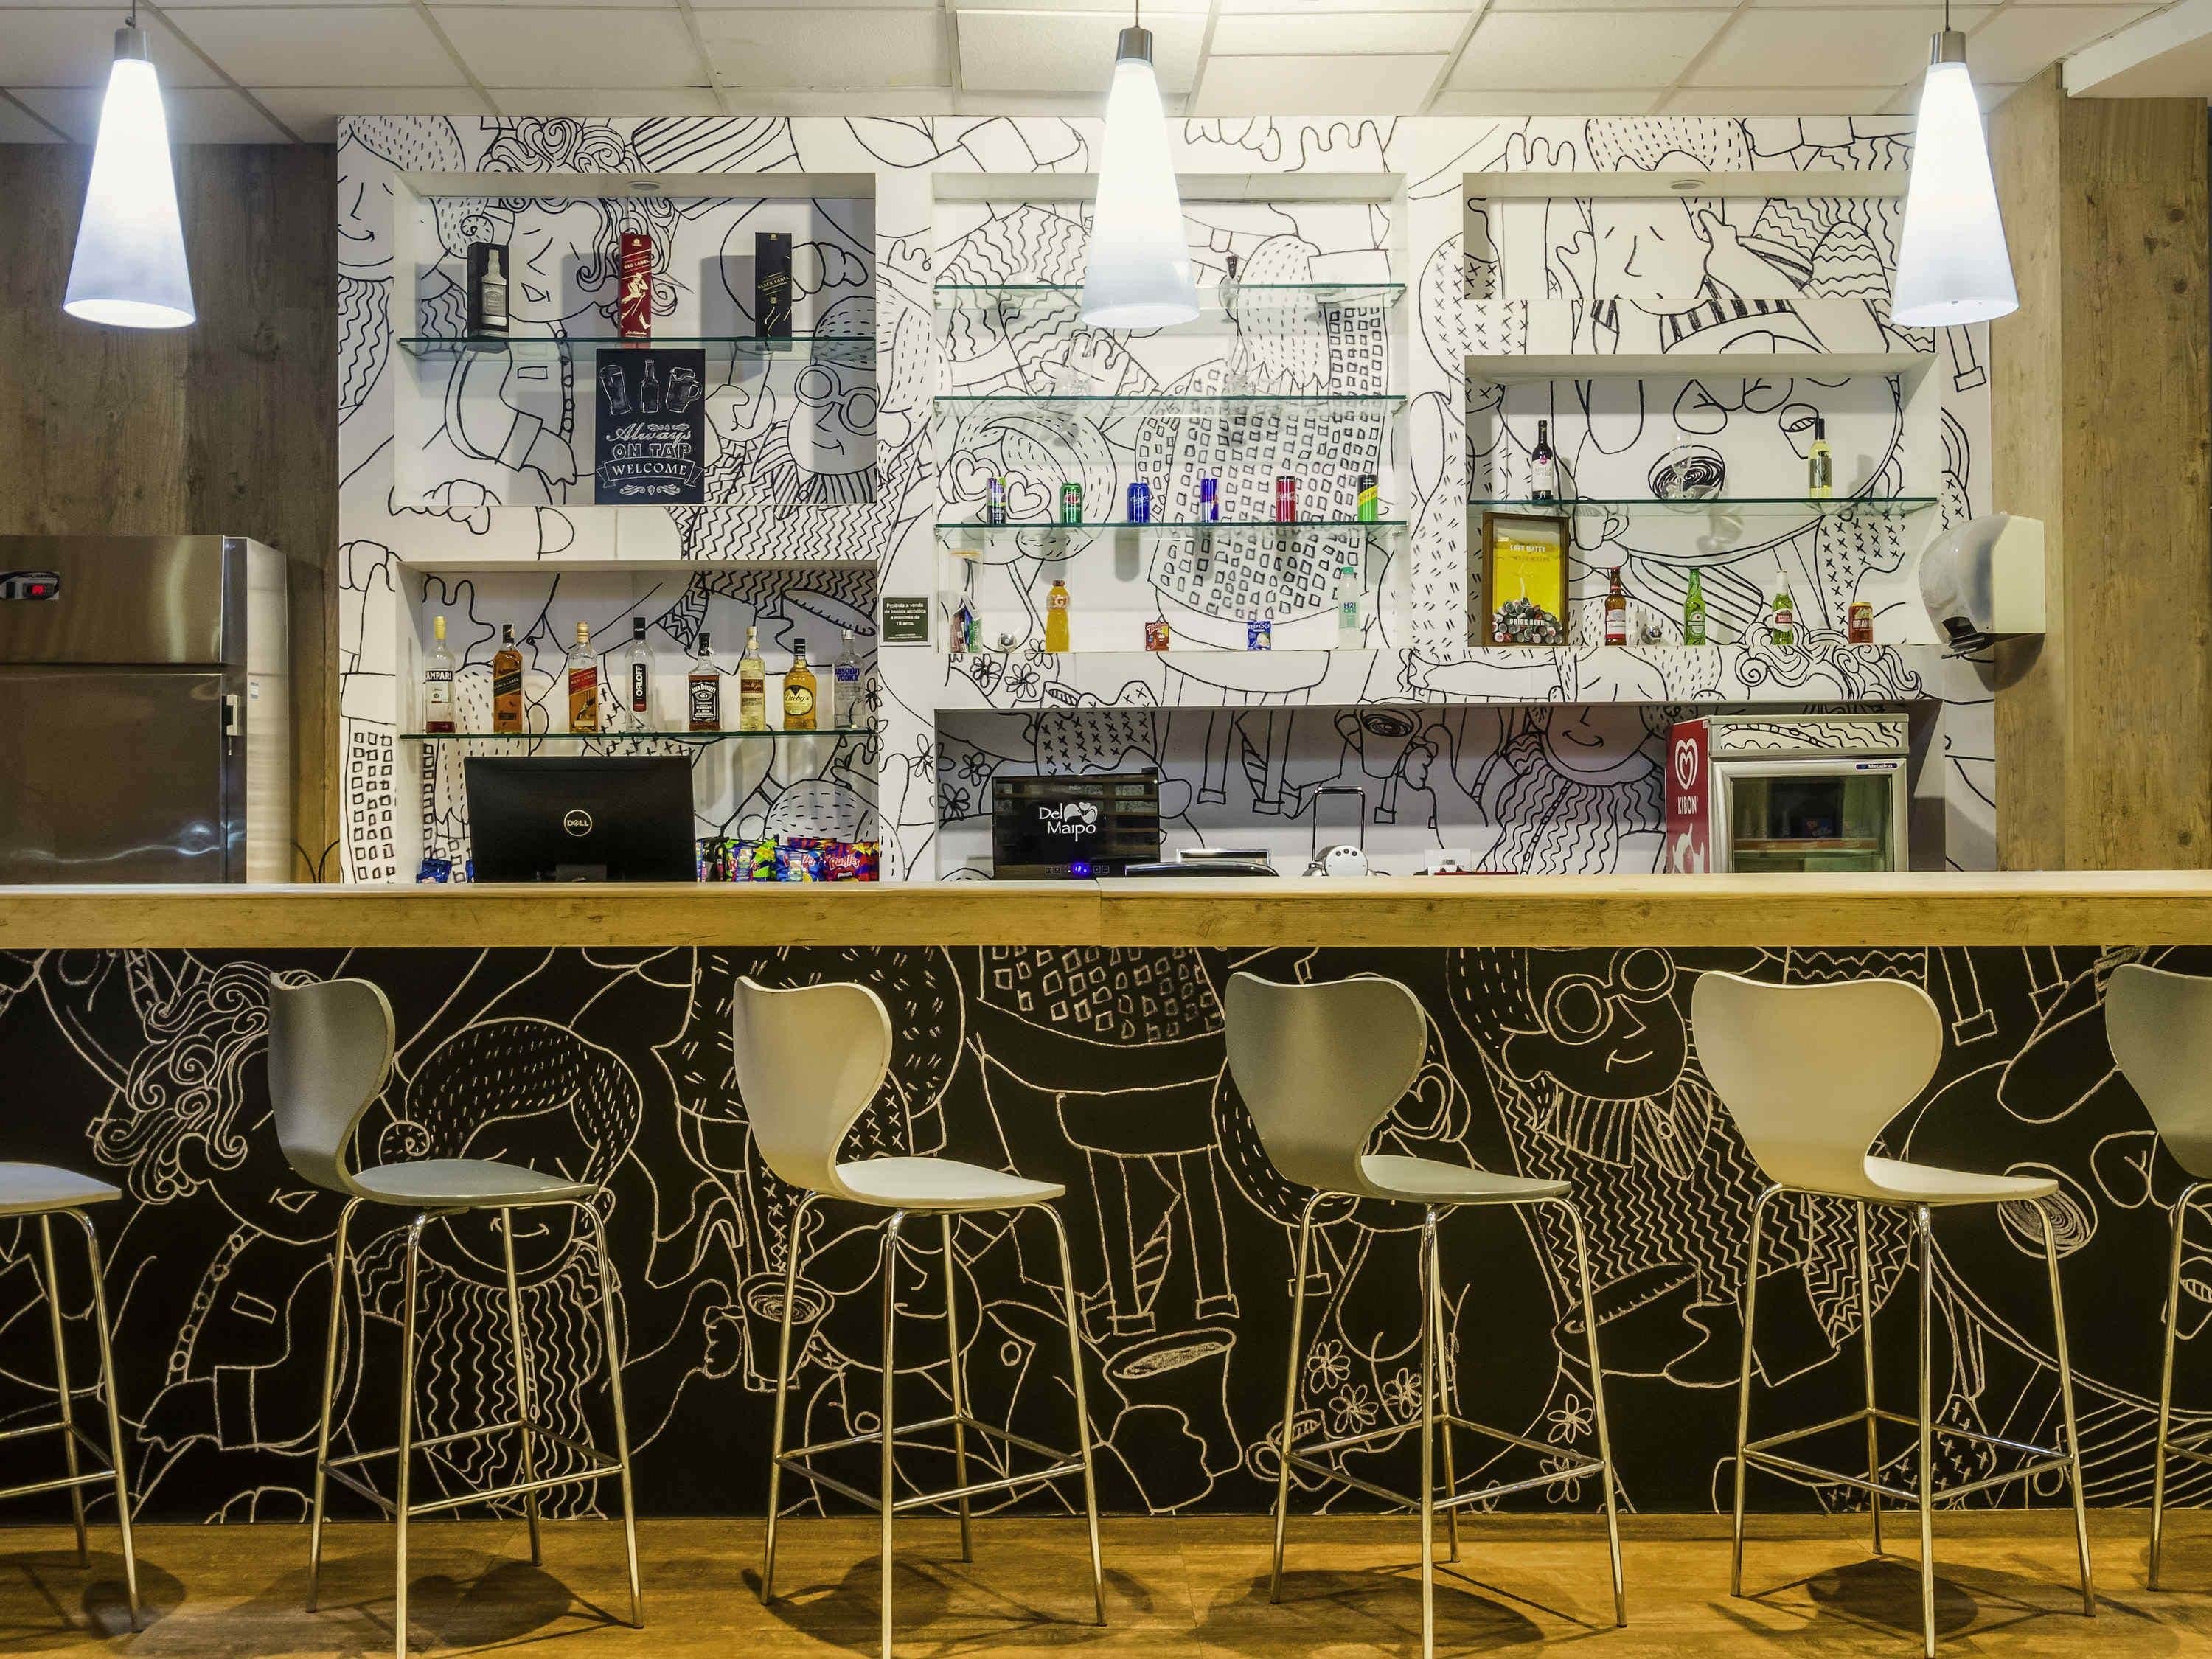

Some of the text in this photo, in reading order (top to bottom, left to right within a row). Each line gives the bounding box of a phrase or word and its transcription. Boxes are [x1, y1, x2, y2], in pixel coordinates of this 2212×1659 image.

[606, 422, 692, 449] Always
[613, 442, 692, 459] ON TAP
[612, 462, 687, 476] WELCOME
[1852, 619, 1871, 628] BRAH
[426, 671, 452, 680] AMPARI
[834, 668, 861, 676] ABSOLUT
[837, 674, 859, 682] VODKA
[1039, 802, 1063, 820] Del
[1677, 796, 1697, 815] KIBON
[1047, 821, 1096, 842] Maipo
[829, 854, 860, 870] Ruffles
